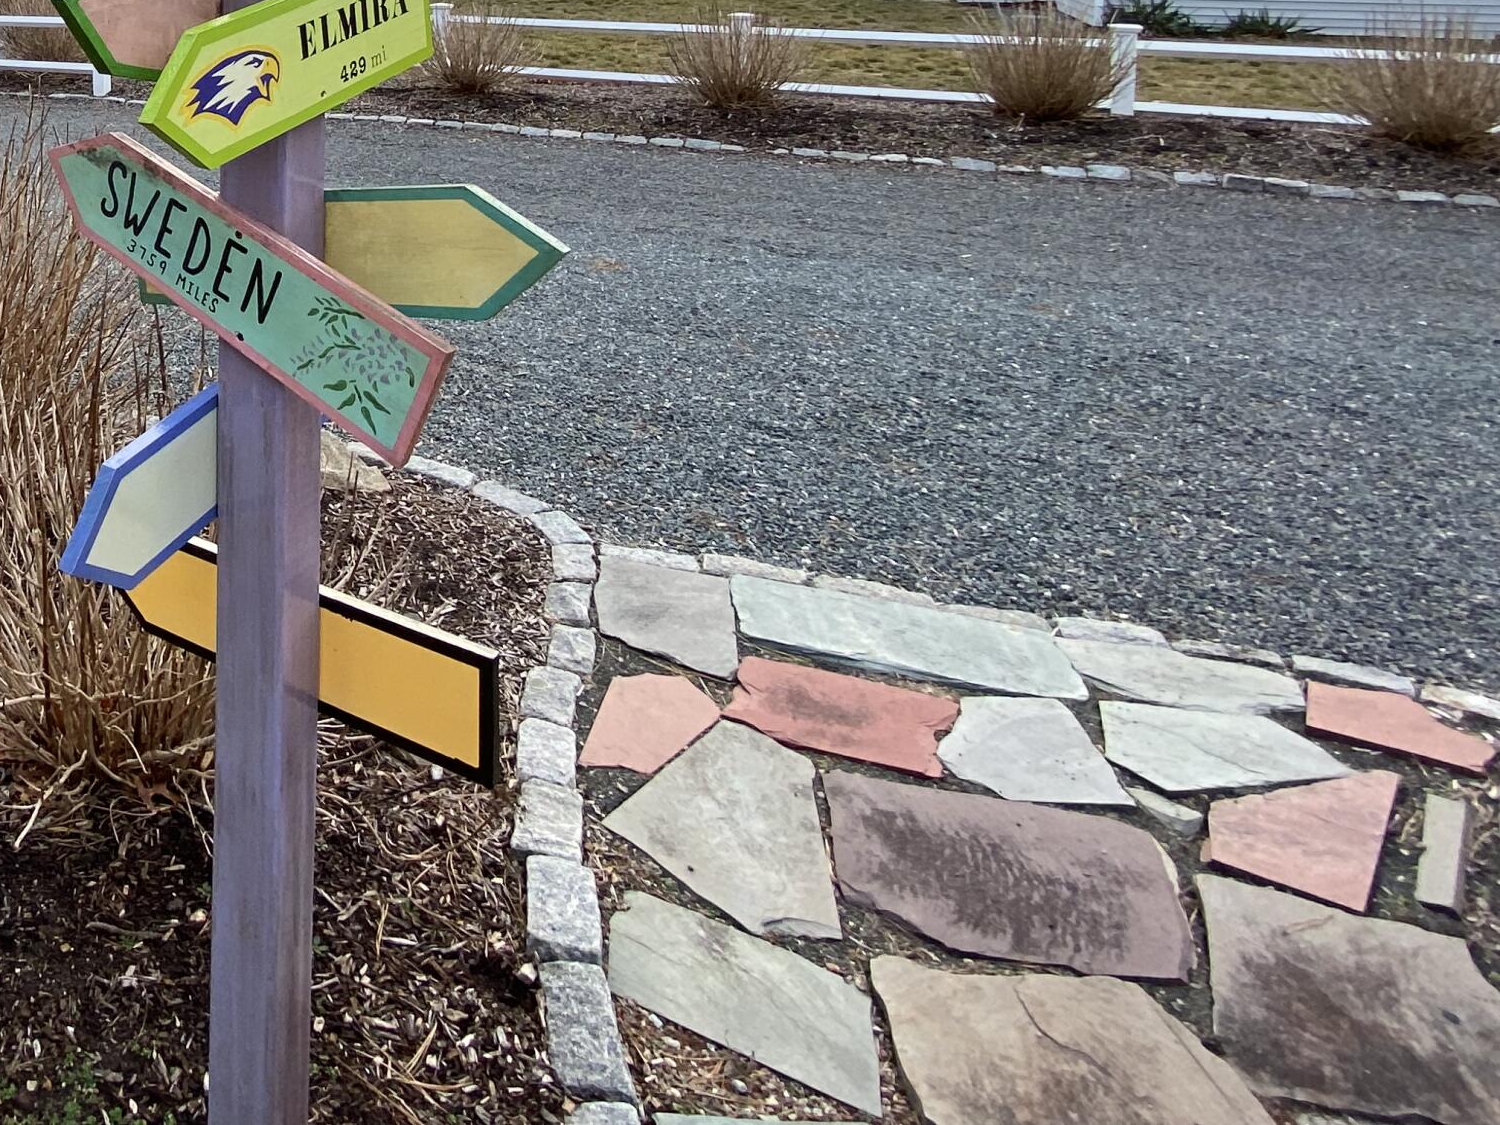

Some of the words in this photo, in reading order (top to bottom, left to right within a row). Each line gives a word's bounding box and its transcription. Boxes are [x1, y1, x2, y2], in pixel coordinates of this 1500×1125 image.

[340, 55, 367, 83] 429
[371, 44, 388, 69] mi
[100, 160, 283, 324] SWEDEN
[126, 238, 168, 275] 3759
[175, 273, 219, 314] MILES
